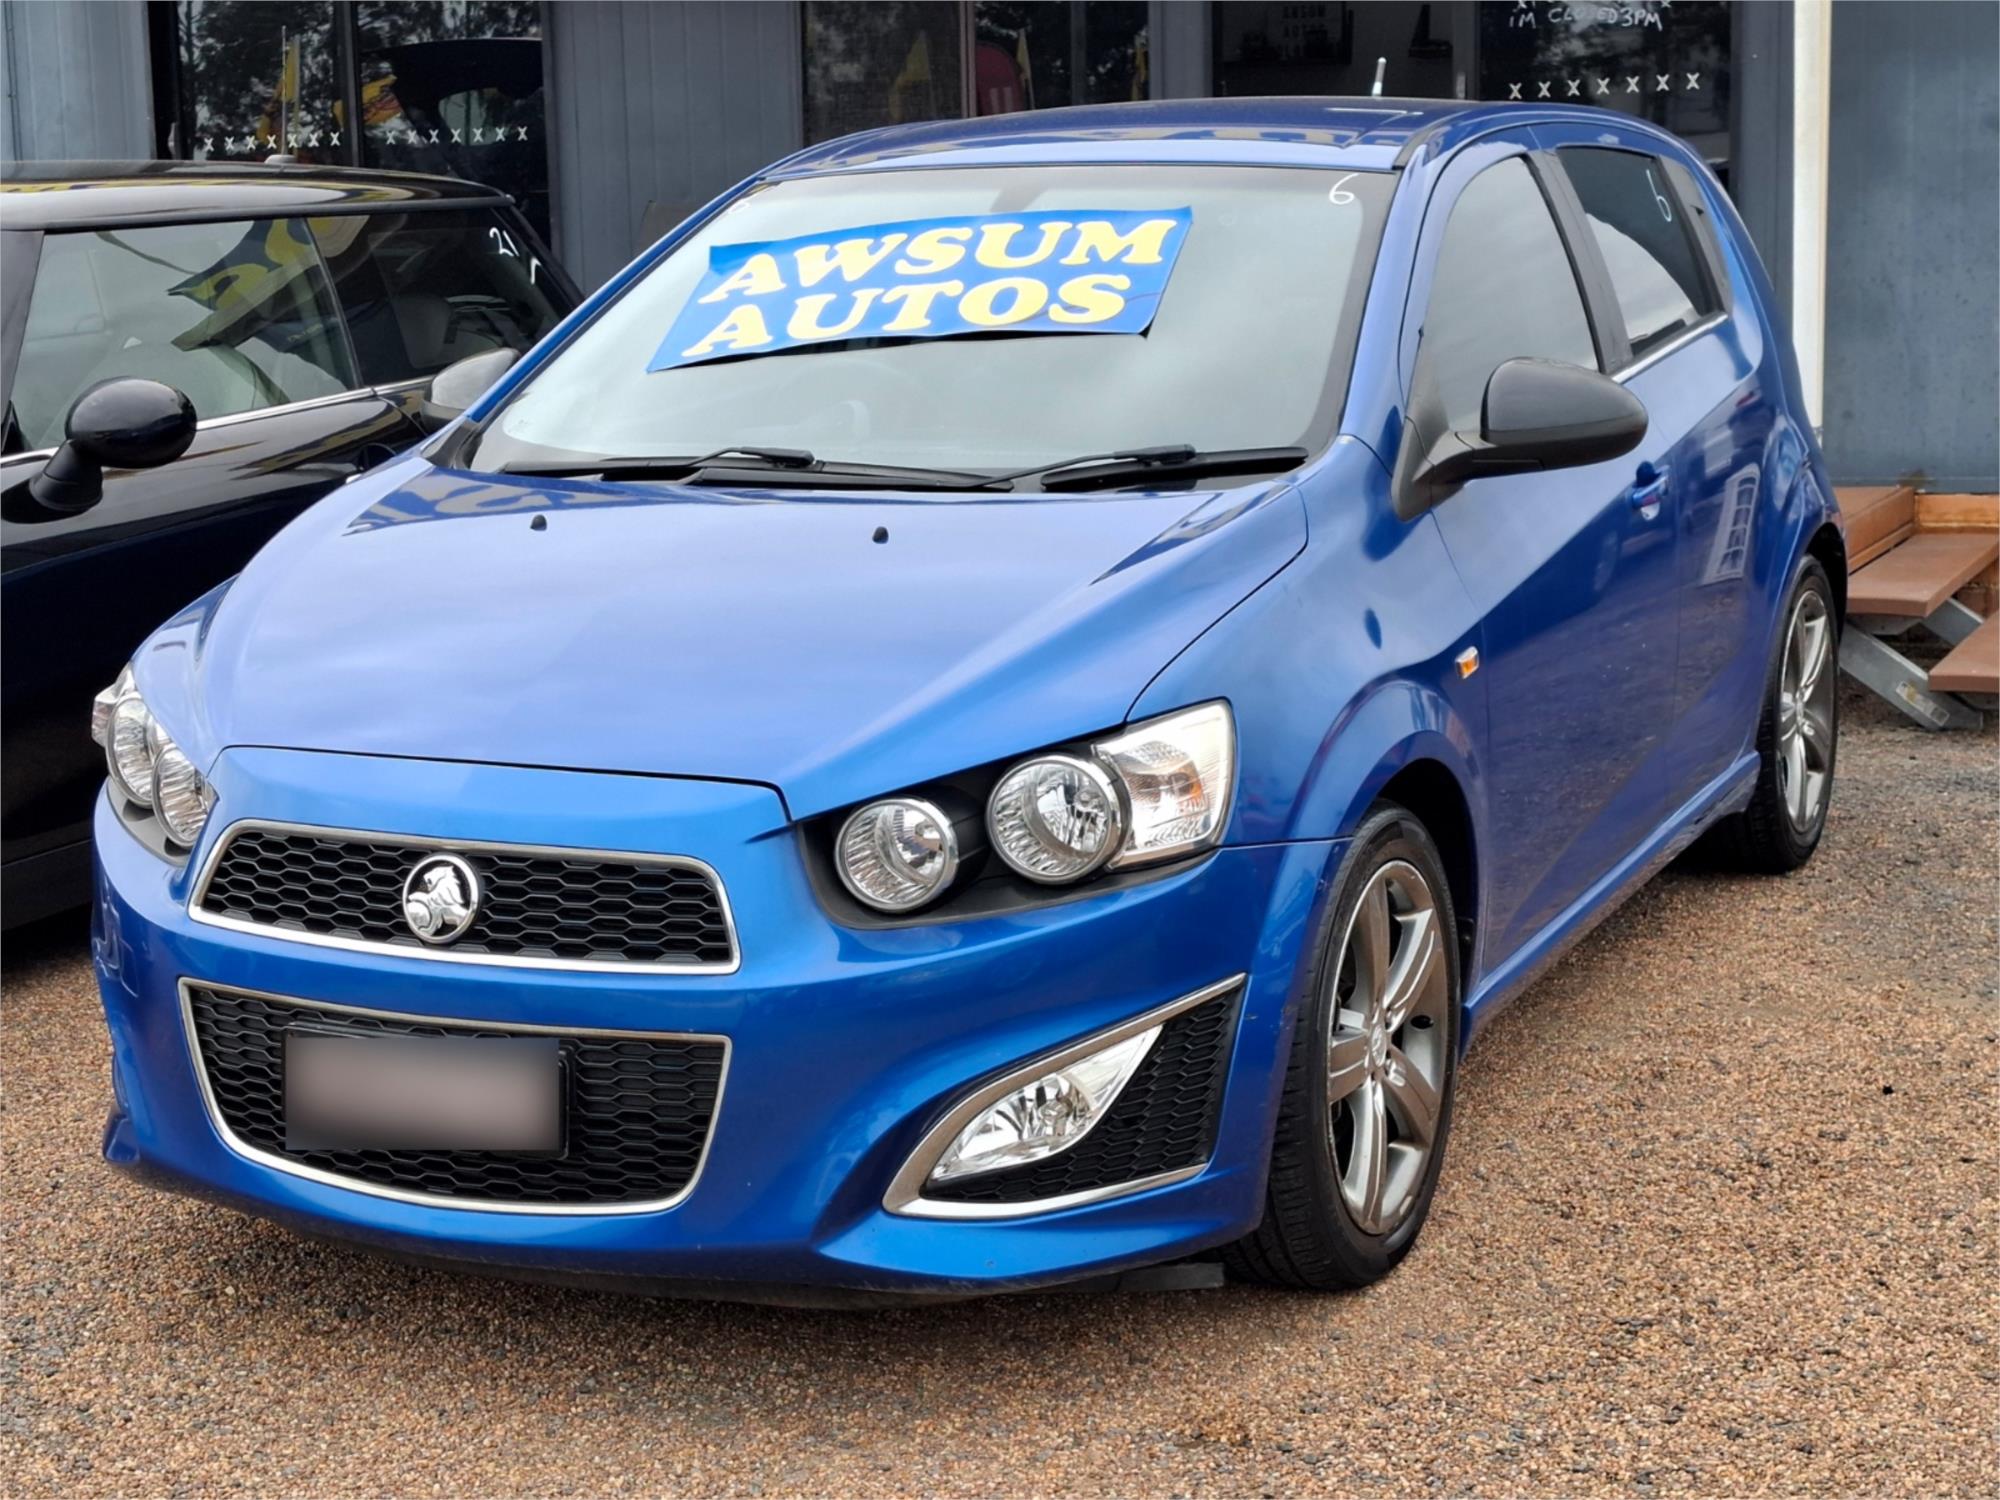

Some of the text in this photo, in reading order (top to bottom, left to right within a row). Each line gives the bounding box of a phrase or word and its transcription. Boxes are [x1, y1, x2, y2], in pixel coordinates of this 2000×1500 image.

[1329, 172, 1360, 205] 6
[1645, 169, 1672, 222] 6
[489, 226, 520, 257] 21
[698, 219, 1177, 303] AWSUM
[682, 275, 1131, 357] AUTOS
